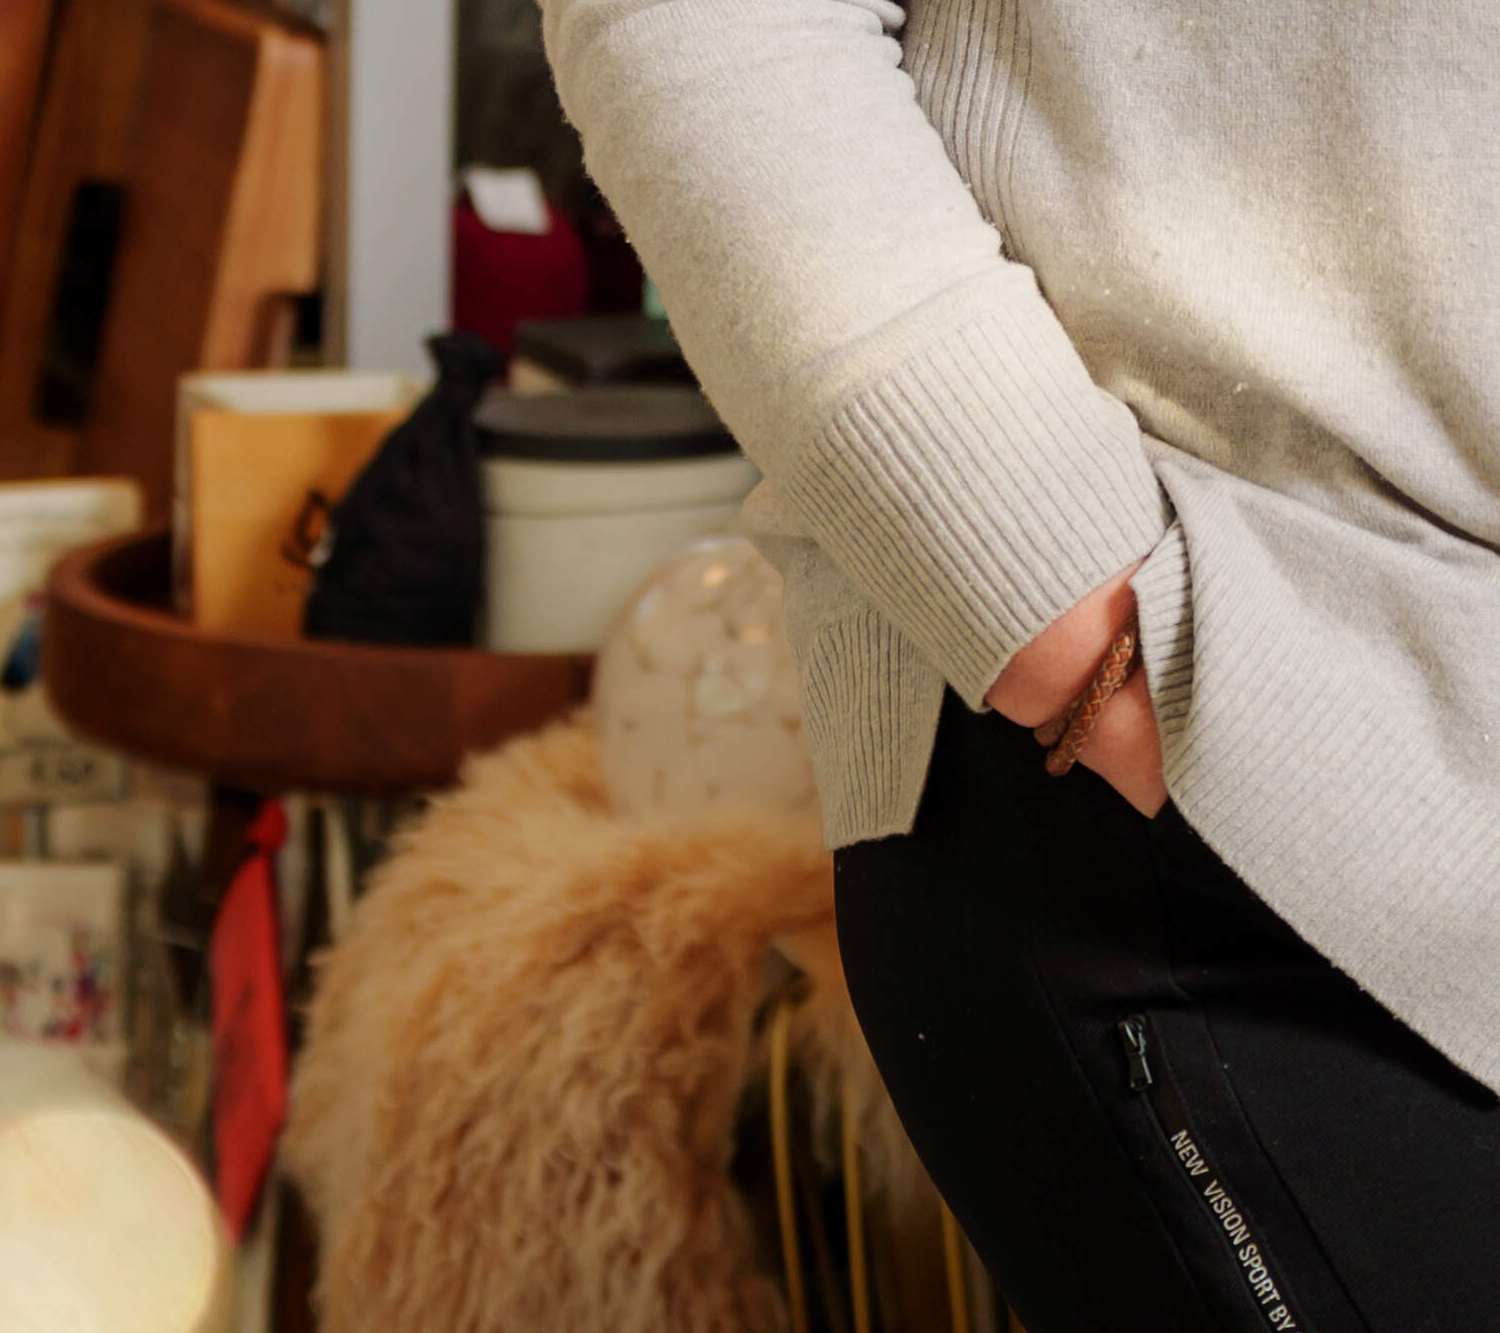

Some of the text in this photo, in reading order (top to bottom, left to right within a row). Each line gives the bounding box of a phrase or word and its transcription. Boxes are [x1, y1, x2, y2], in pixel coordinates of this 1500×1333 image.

[1170, 1129, 1296, 1331] NEW VISION SPORT BY
